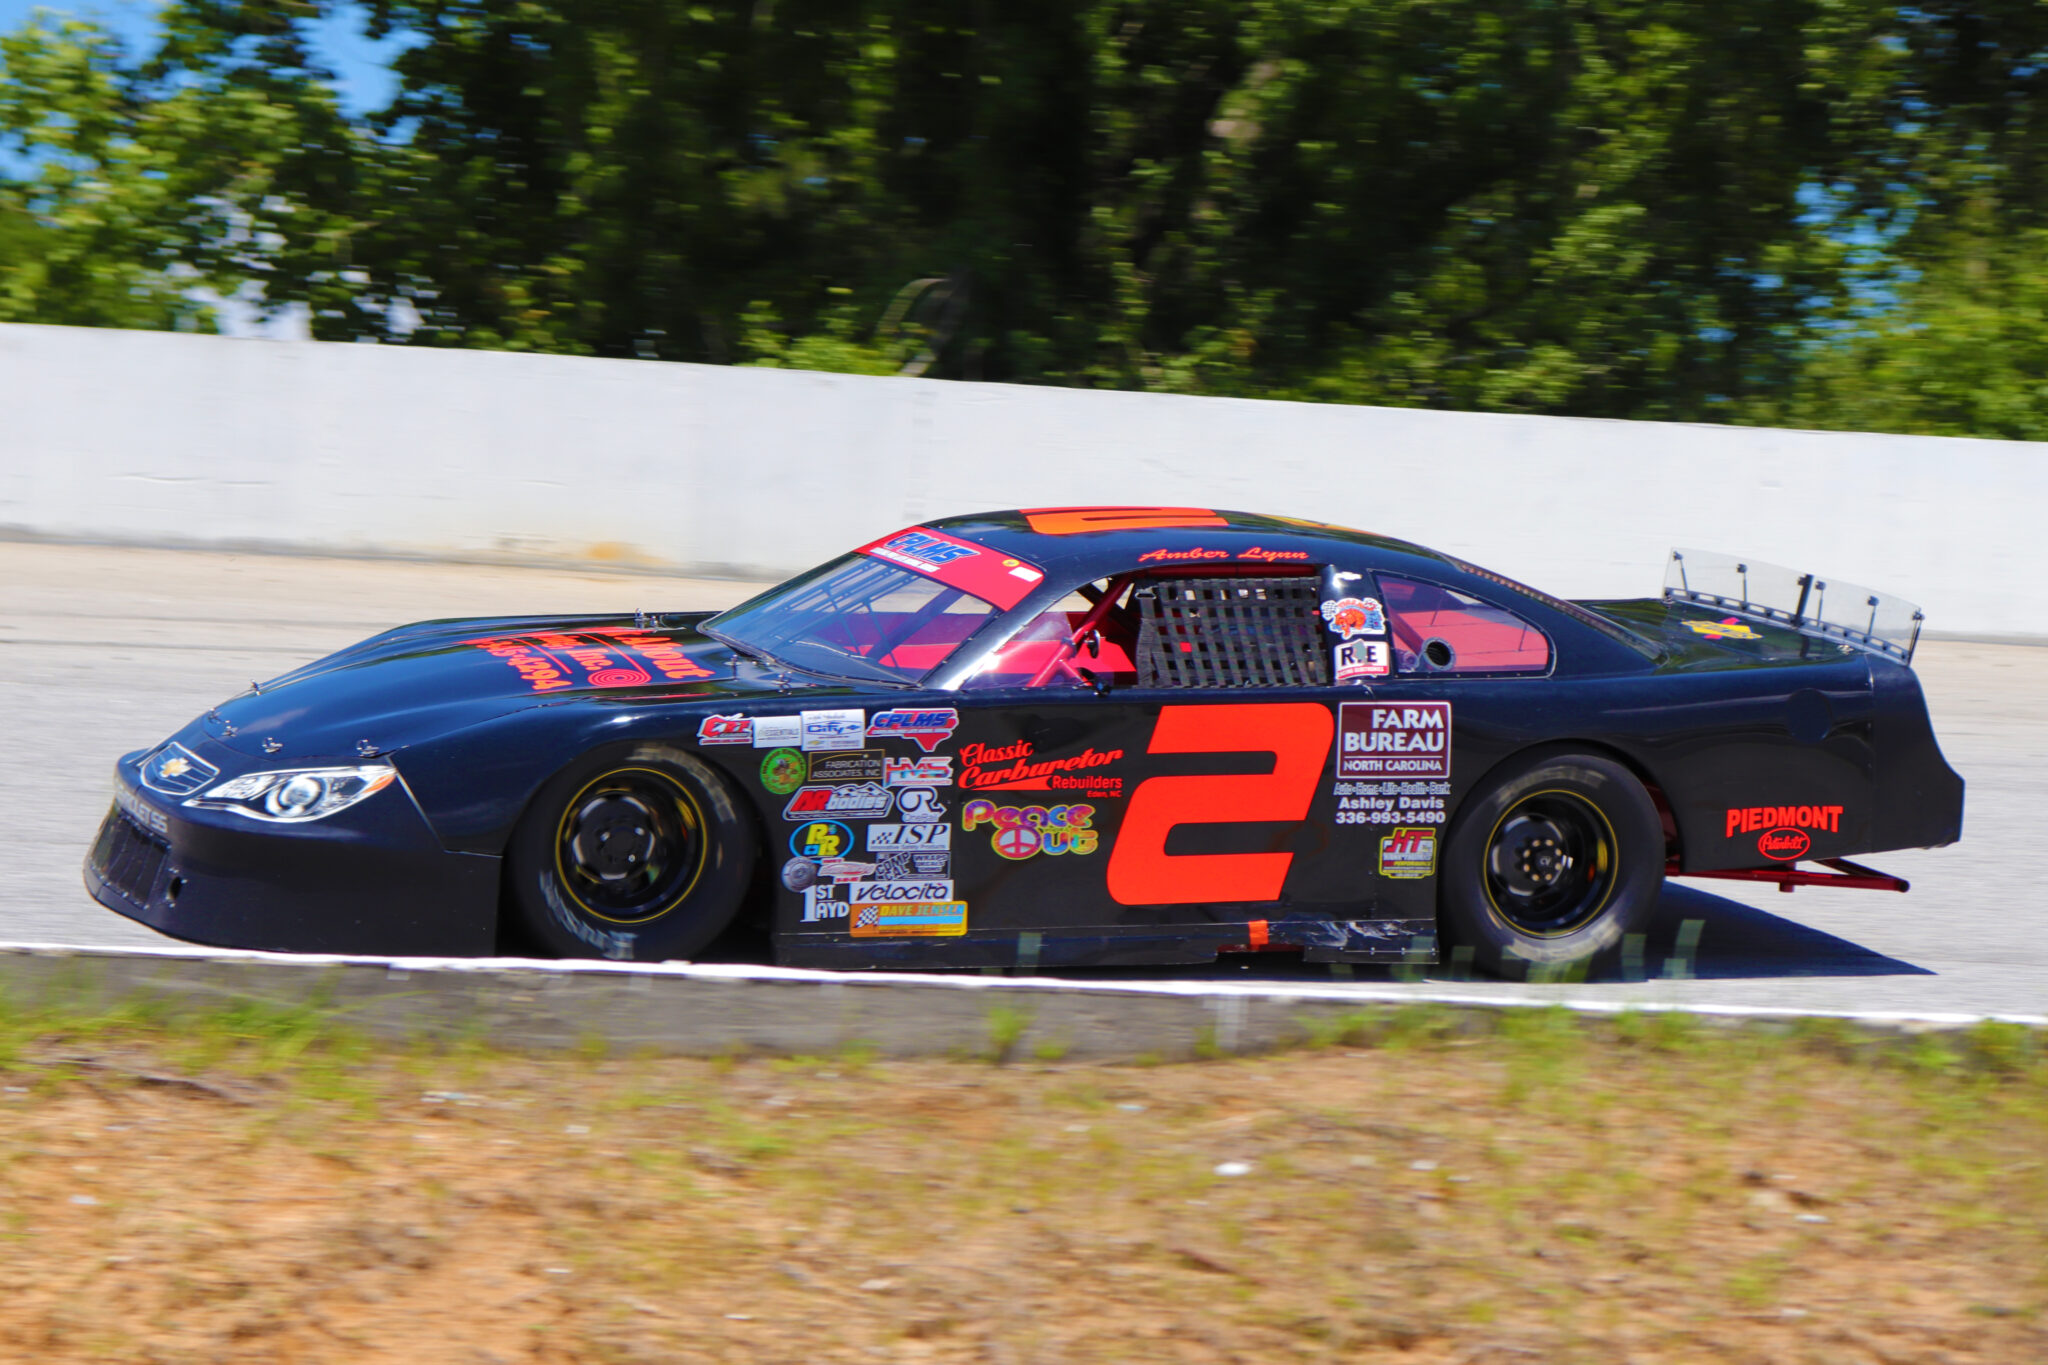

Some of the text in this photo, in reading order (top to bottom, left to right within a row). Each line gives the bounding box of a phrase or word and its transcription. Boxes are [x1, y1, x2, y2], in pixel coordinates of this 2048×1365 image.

[883, 532, 981, 564] CPLMS
[1138, 547, 1310, 562] Amber Lynn
[613, 636, 716, 679] About
[808, 722, 845, 735] City
[874, 711, 952, 728] CPLMS
[1372, 709, 1444, 729] FARM
[1344, 732, 1444, 752] BUREAU
[959, 739, 1034, 767] Classic
[825, 760, 880, 768] FABRICATION
[958, 748, 1124, 788] Carburetor
[1343, 760, 1442, 771] NORTH CAROLINA
[1052, 776, 1122, 789] Rebuilders
[1106, 702, 1334, 906] 2
[1338, 796, 1445, 811] Ashley Davis
[962, 799, 1096, 831] Peace
[1335, 811, 1446, 824] 336-993-5490
[1725, 805, 1844, 838] PIEDMONT
[893, 824, 948, 845] ISP
[876, 852, 911, 874] COMP
[816, 901, 849, 919] AYD
[879, 904, 965, 916] DAVE JENSEN
